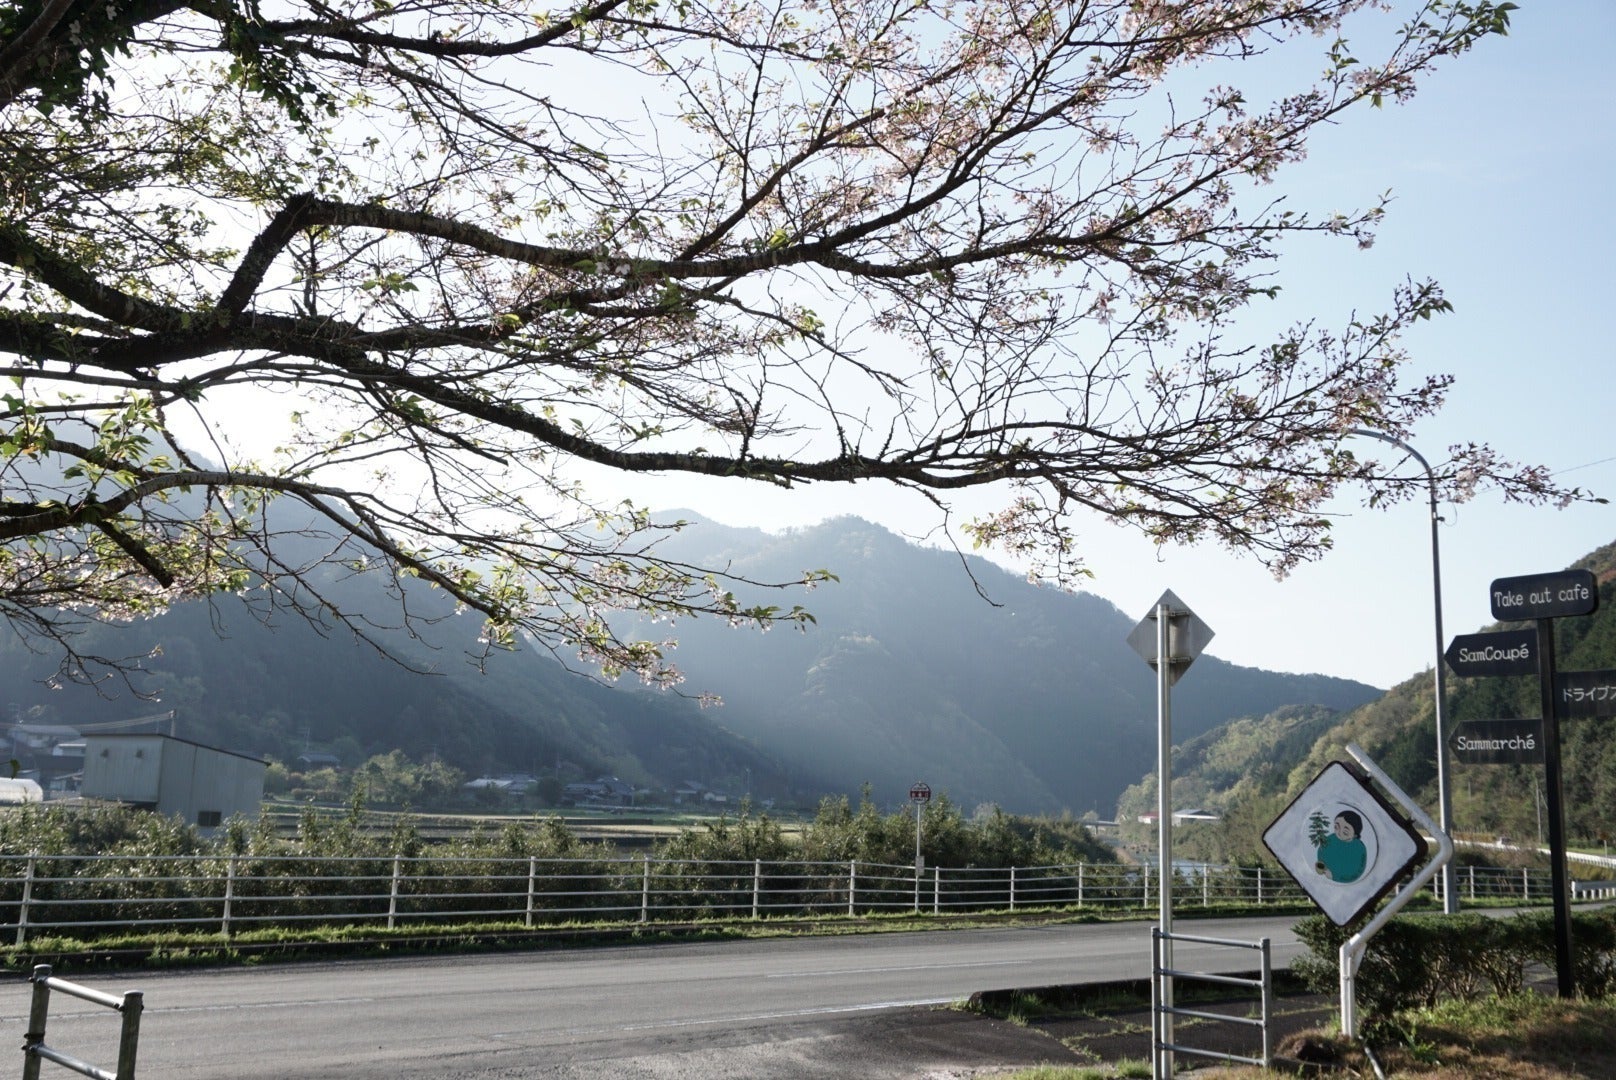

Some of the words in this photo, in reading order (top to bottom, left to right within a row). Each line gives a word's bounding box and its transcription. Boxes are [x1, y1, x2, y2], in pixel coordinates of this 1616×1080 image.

[1494, 591, 1524, 607] Take
[1529, 587, 1552, 604] out
[1558, 583, 1589, 600] cafe
[1459, 643, 1529, 663] SamCoupé
[1457, 734, 1535, 751] Sammarché
